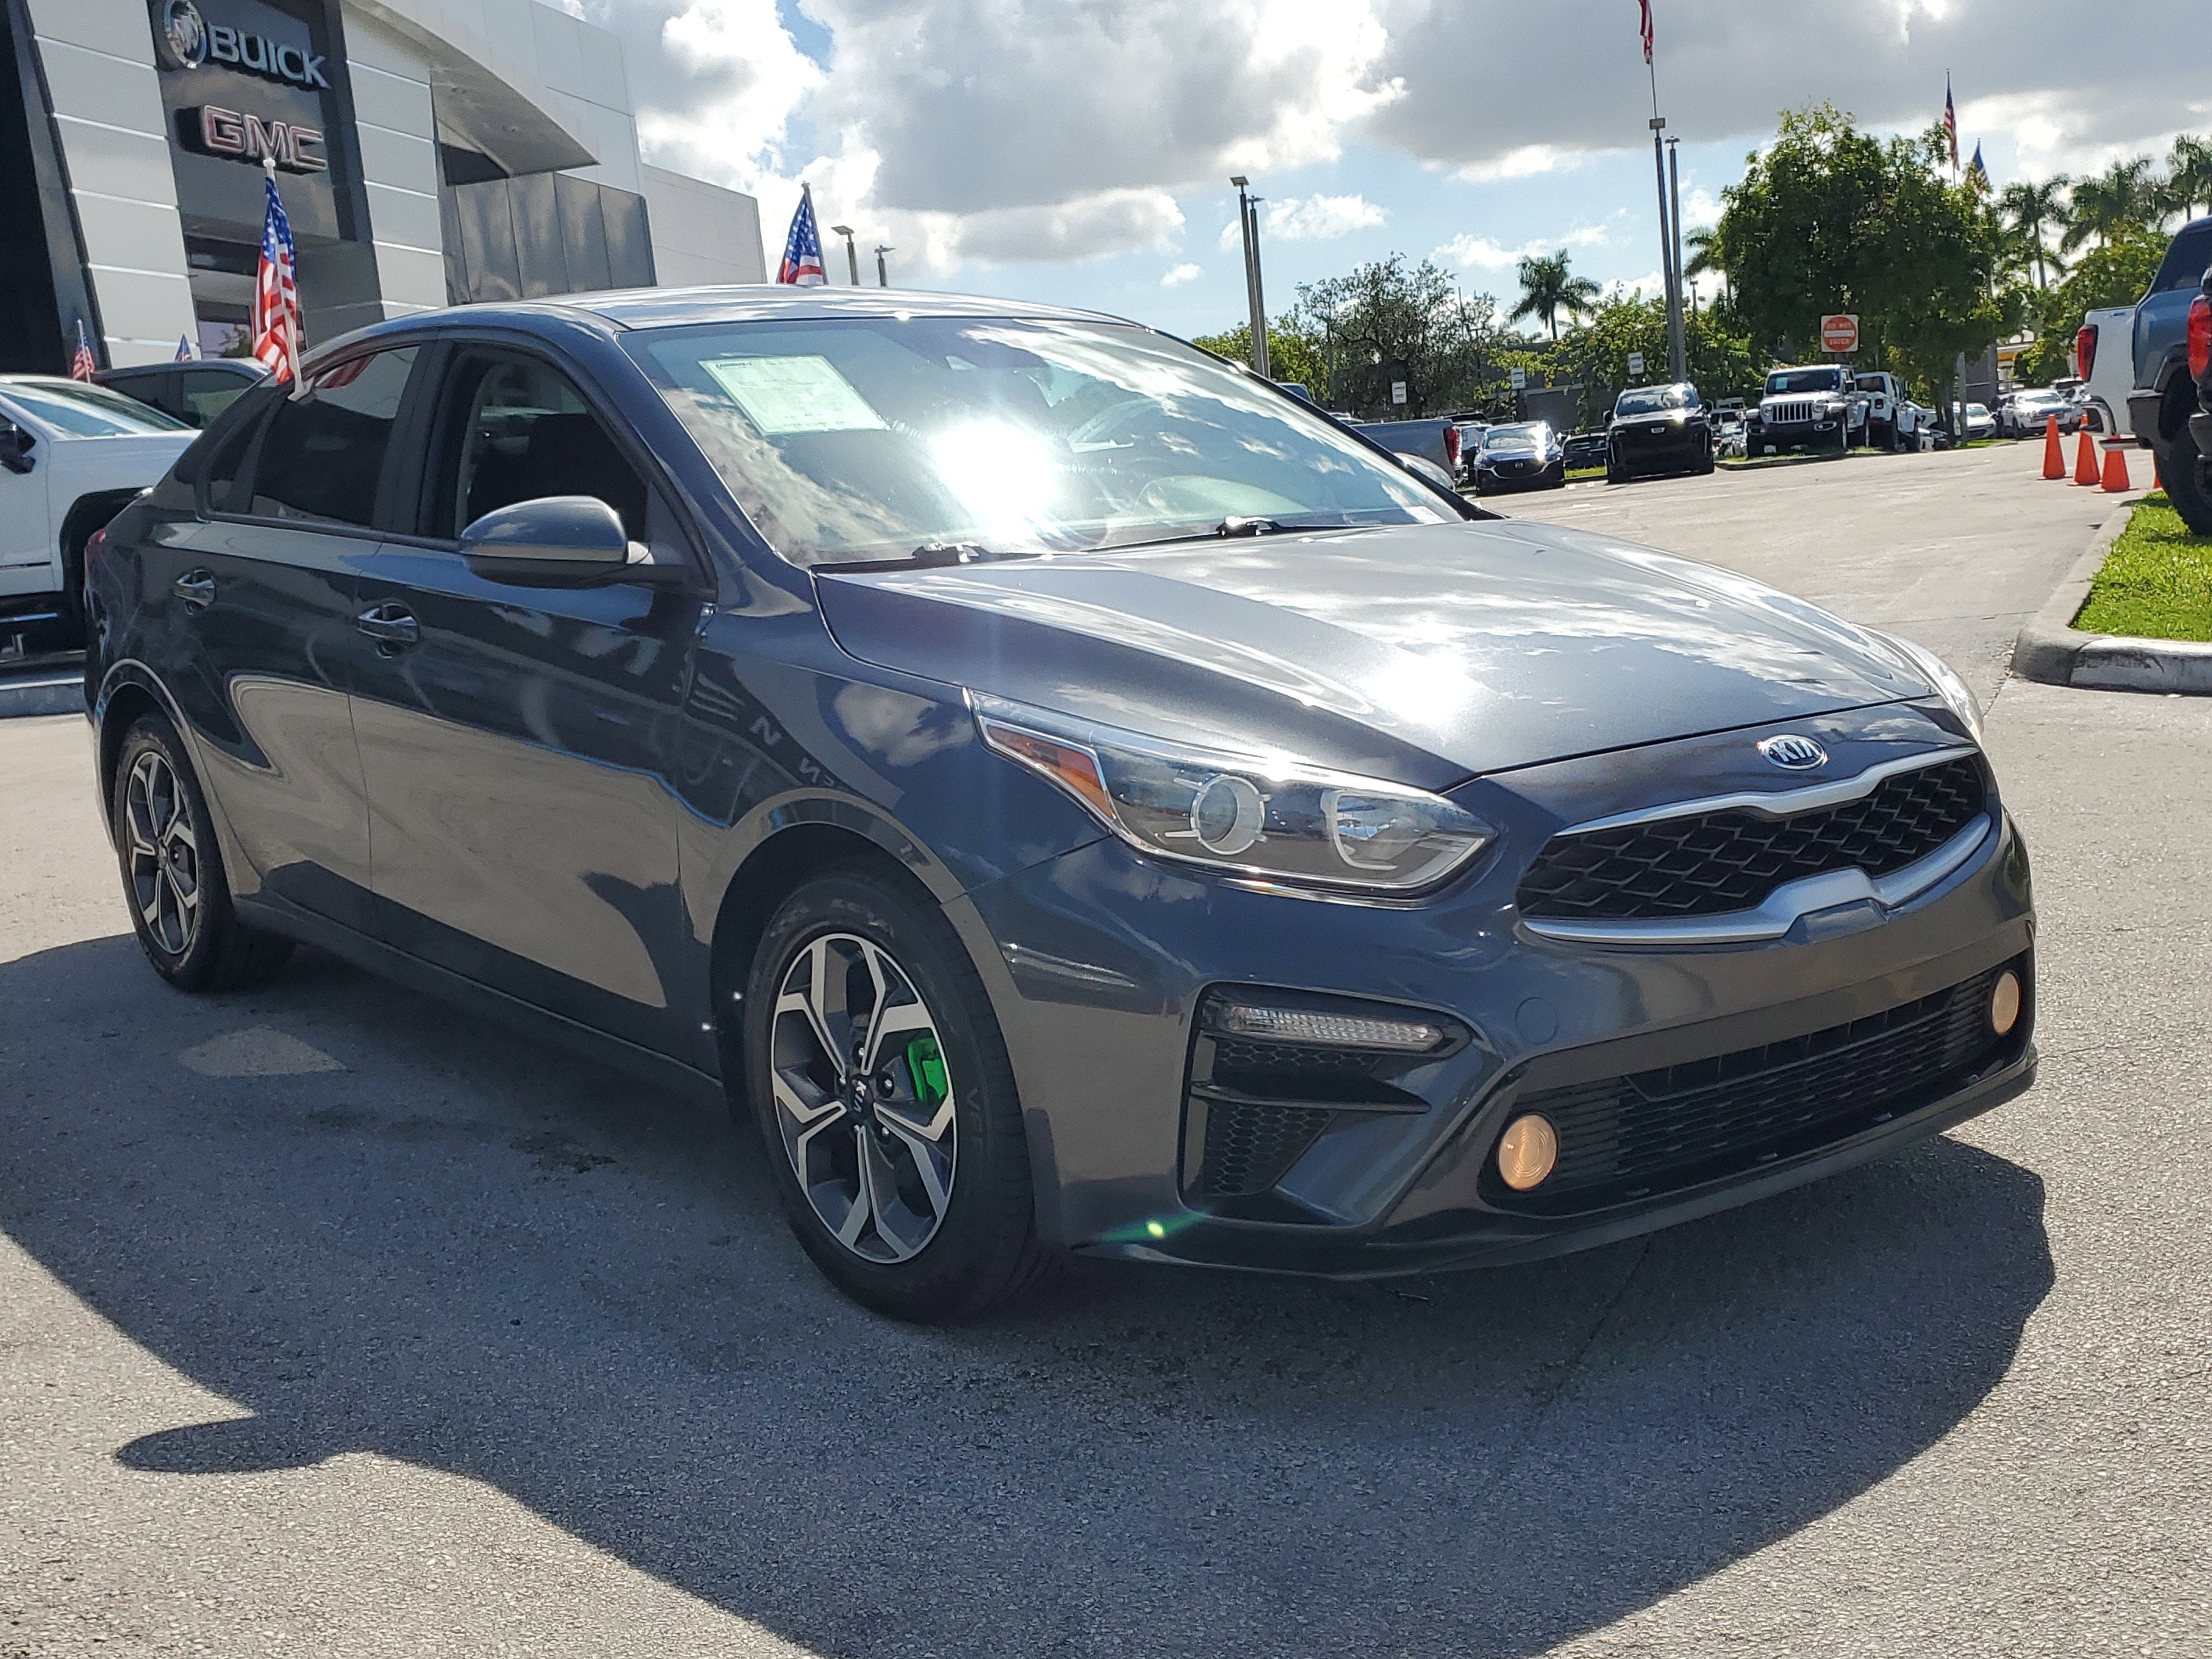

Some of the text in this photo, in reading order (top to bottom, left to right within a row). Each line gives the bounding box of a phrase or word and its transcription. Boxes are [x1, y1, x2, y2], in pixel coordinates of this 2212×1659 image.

[206, 22, 331, 89] BUICK
[204, 105, 328, 172] GMC
[1769, 738, 1822, 763] KIA
[853, 1080, 867, 1113] KIA
